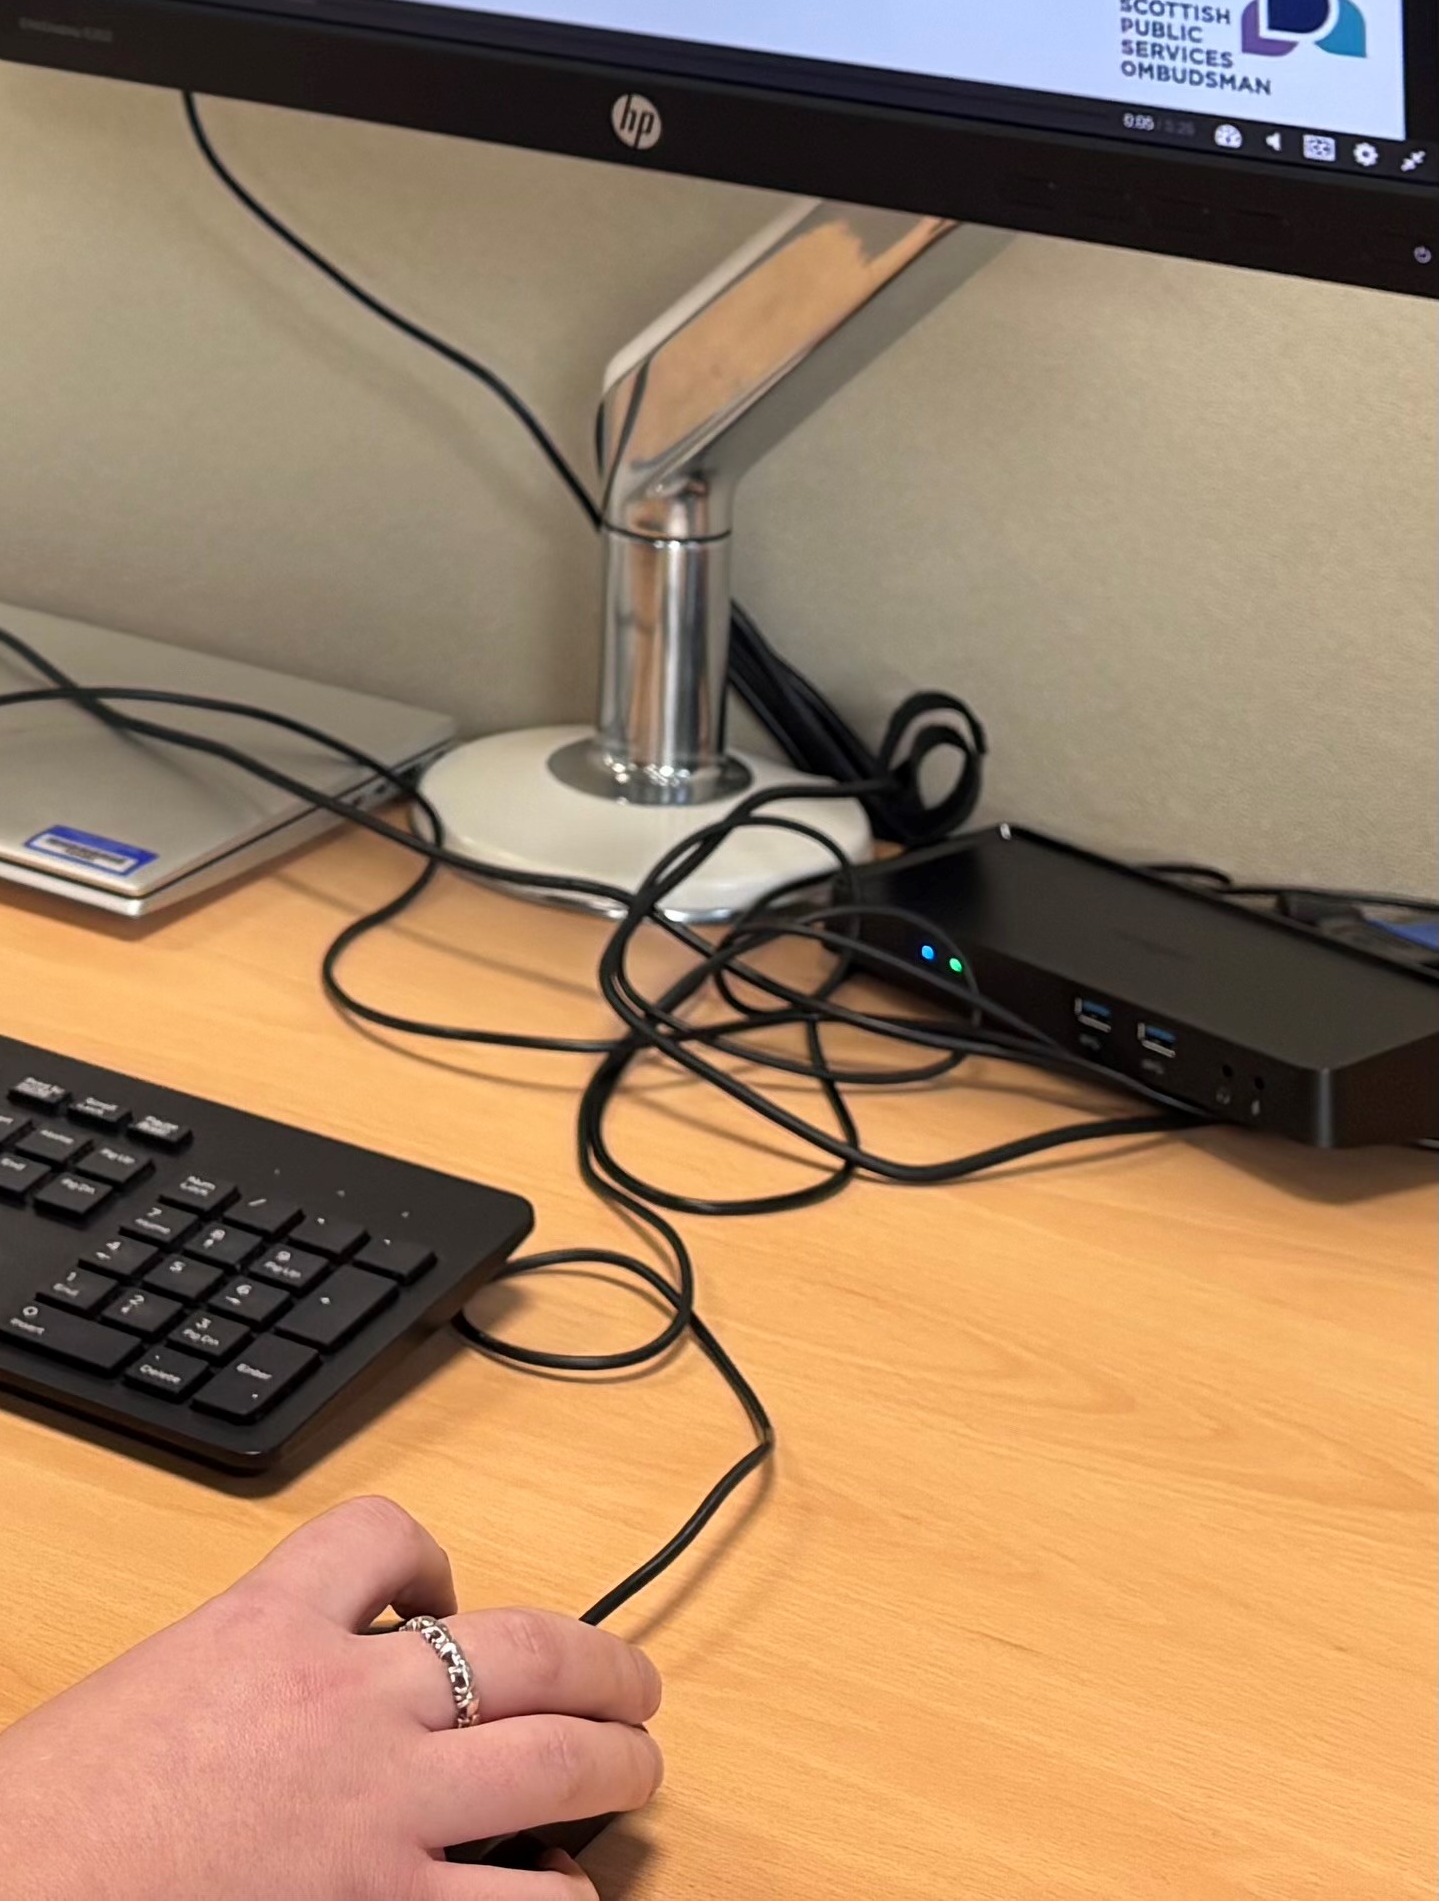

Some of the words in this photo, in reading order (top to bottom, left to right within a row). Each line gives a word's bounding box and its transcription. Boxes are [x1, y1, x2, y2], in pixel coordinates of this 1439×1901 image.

[1120, 19, 1204, 45] PUBLIC
[1120, 40, 1234, 69] SERVICES
[1120, 61, 1272, 96] OMBUDSMAN
[614, 94, 660, 148] hp
[1, 1157, 27, 1172] End
[186, 1175, 216, 1191] Num
[147, 1206, 163, 1217] 7
[22, 1305, 39, 1317] 0
[140, 1363, 182, 1385] Delete
[235, 1362, 274, 1380] Enter
